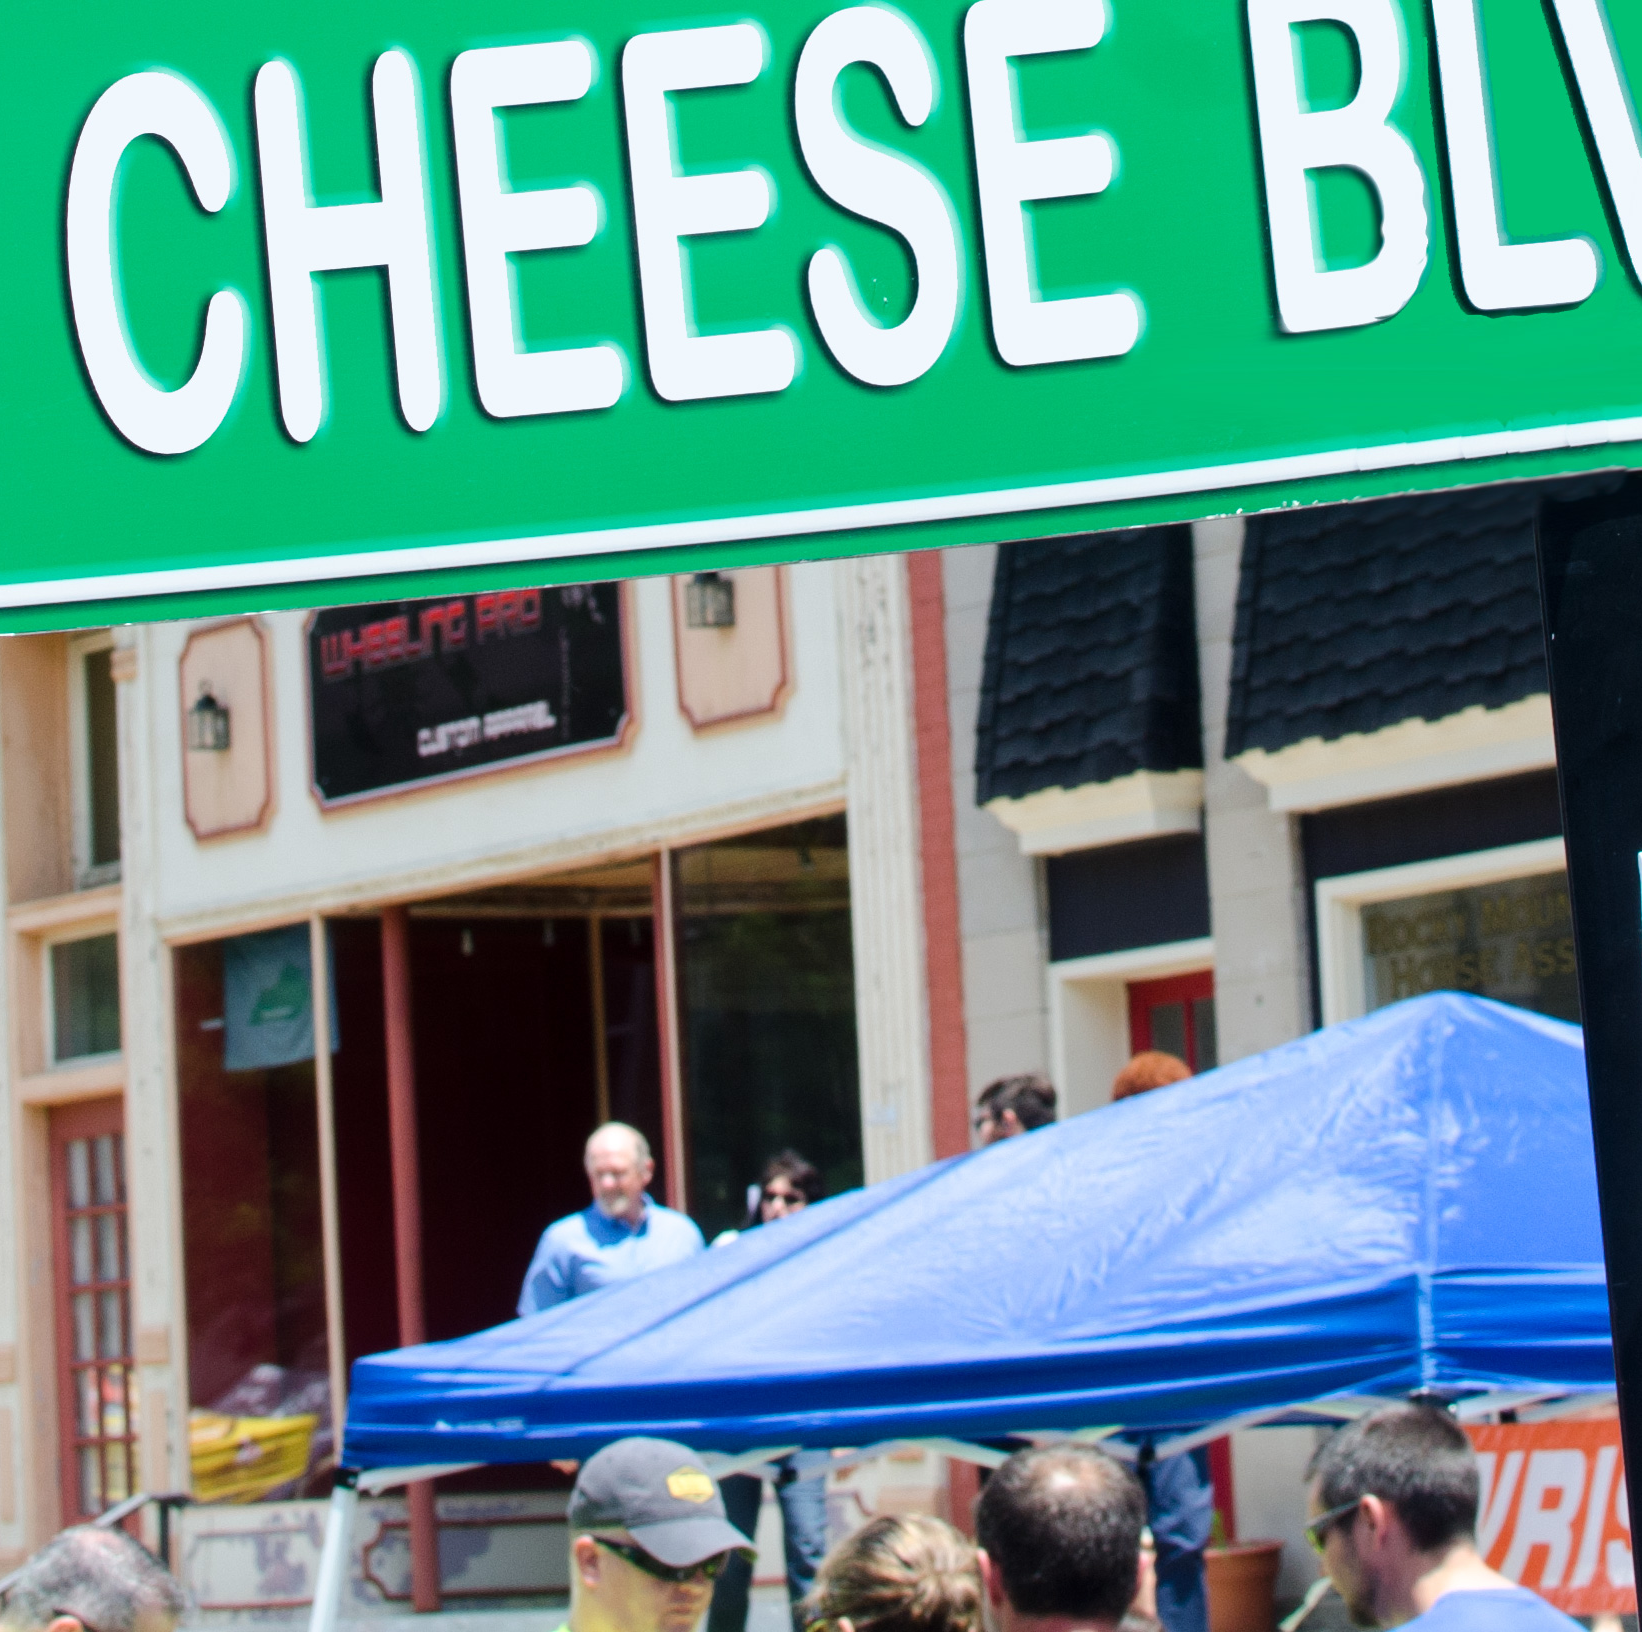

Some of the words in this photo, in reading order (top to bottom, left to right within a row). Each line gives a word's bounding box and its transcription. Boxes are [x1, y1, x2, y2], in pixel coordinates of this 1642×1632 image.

[474, 588, 543, 645] PRO
[417, 716, 481, 757] CUSTOM
[483, 699, 557, 739] APPAREL
